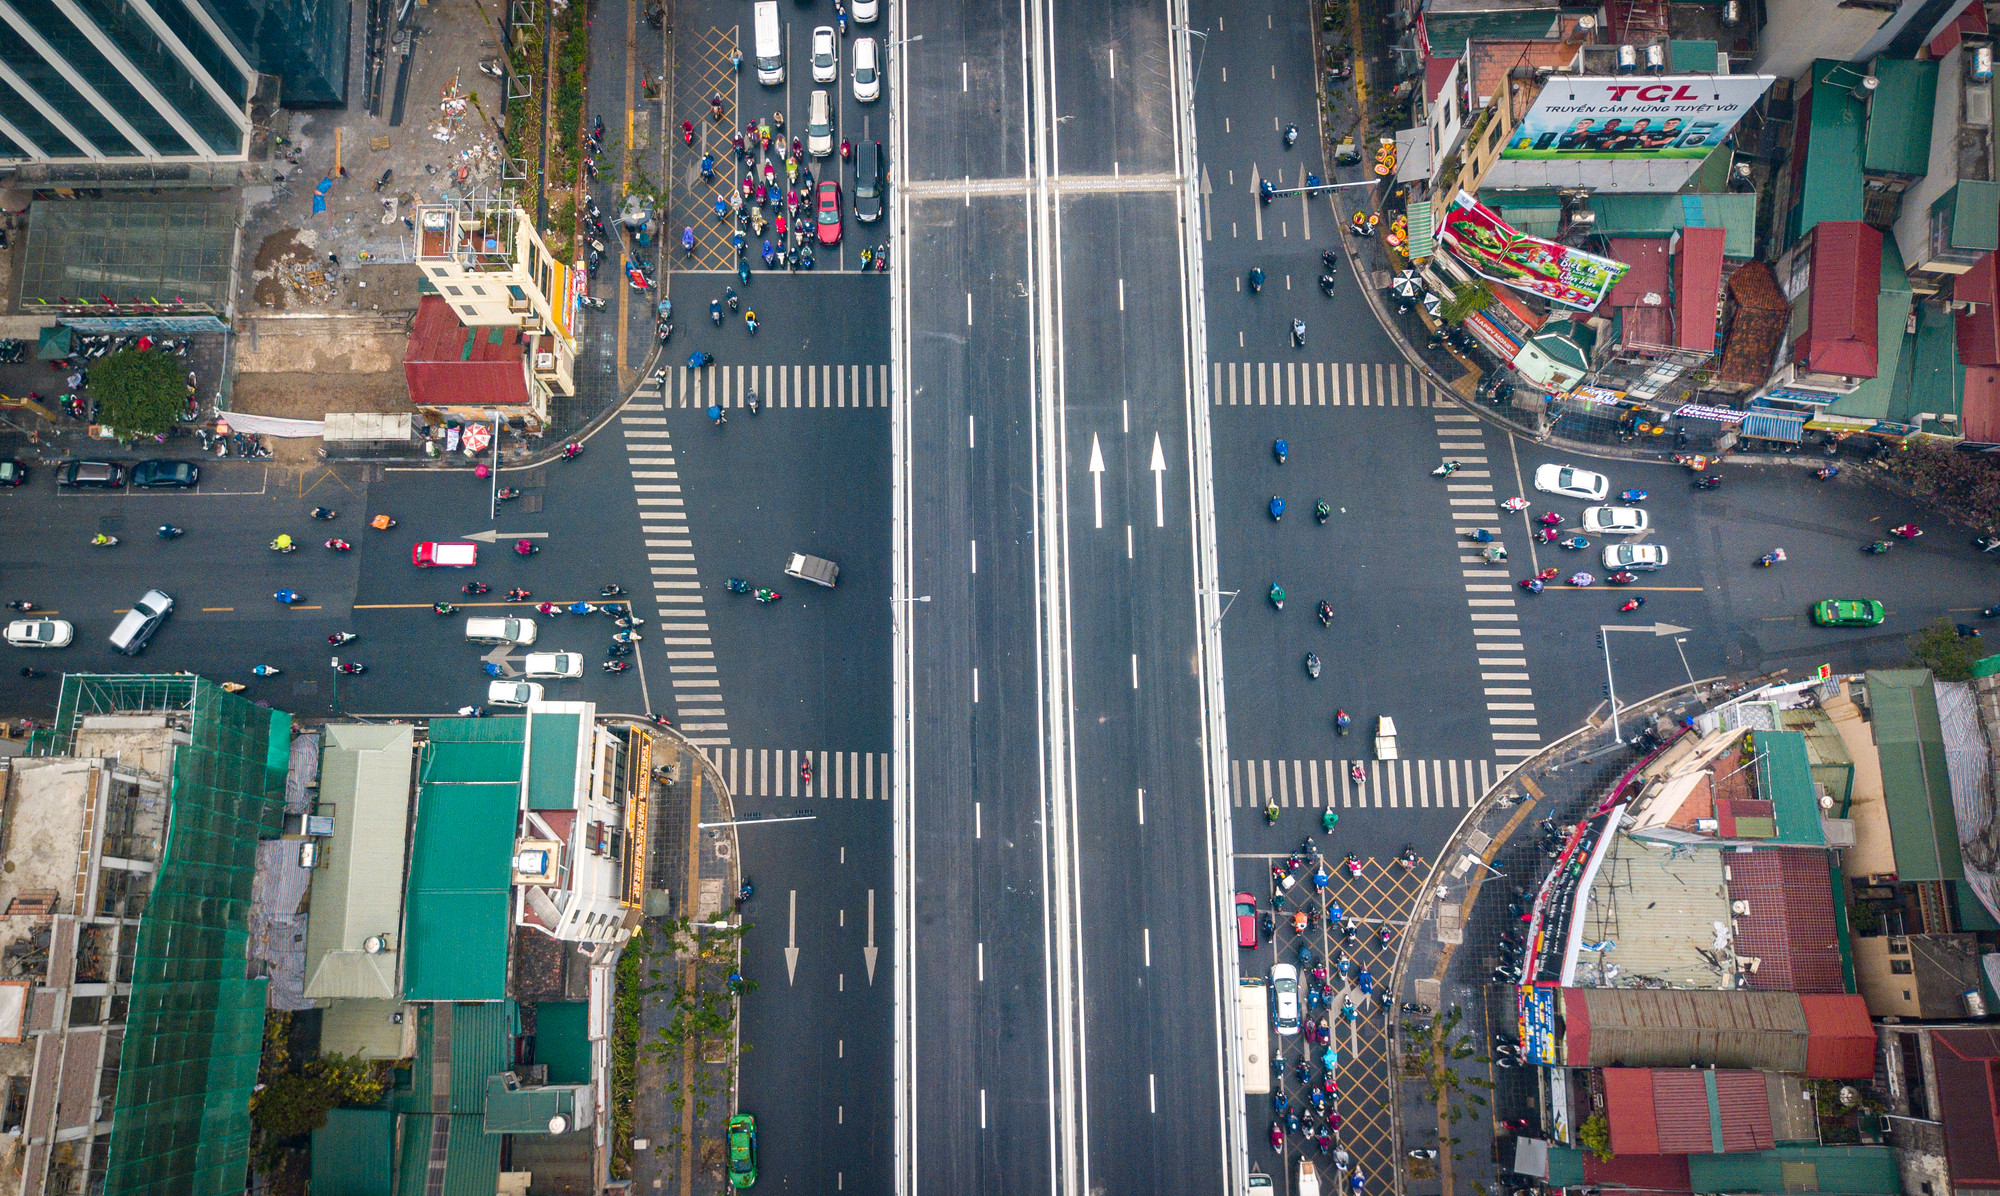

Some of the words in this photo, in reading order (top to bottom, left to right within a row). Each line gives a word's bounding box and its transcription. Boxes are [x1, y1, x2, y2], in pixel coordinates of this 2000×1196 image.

[1606, 85, 1699, 102] TCL
[1603, 266, 1623, 275] OMO
[1474, 316, 1496, 335] HAPPY
[1494, 333, 1516, 352] MONEY
